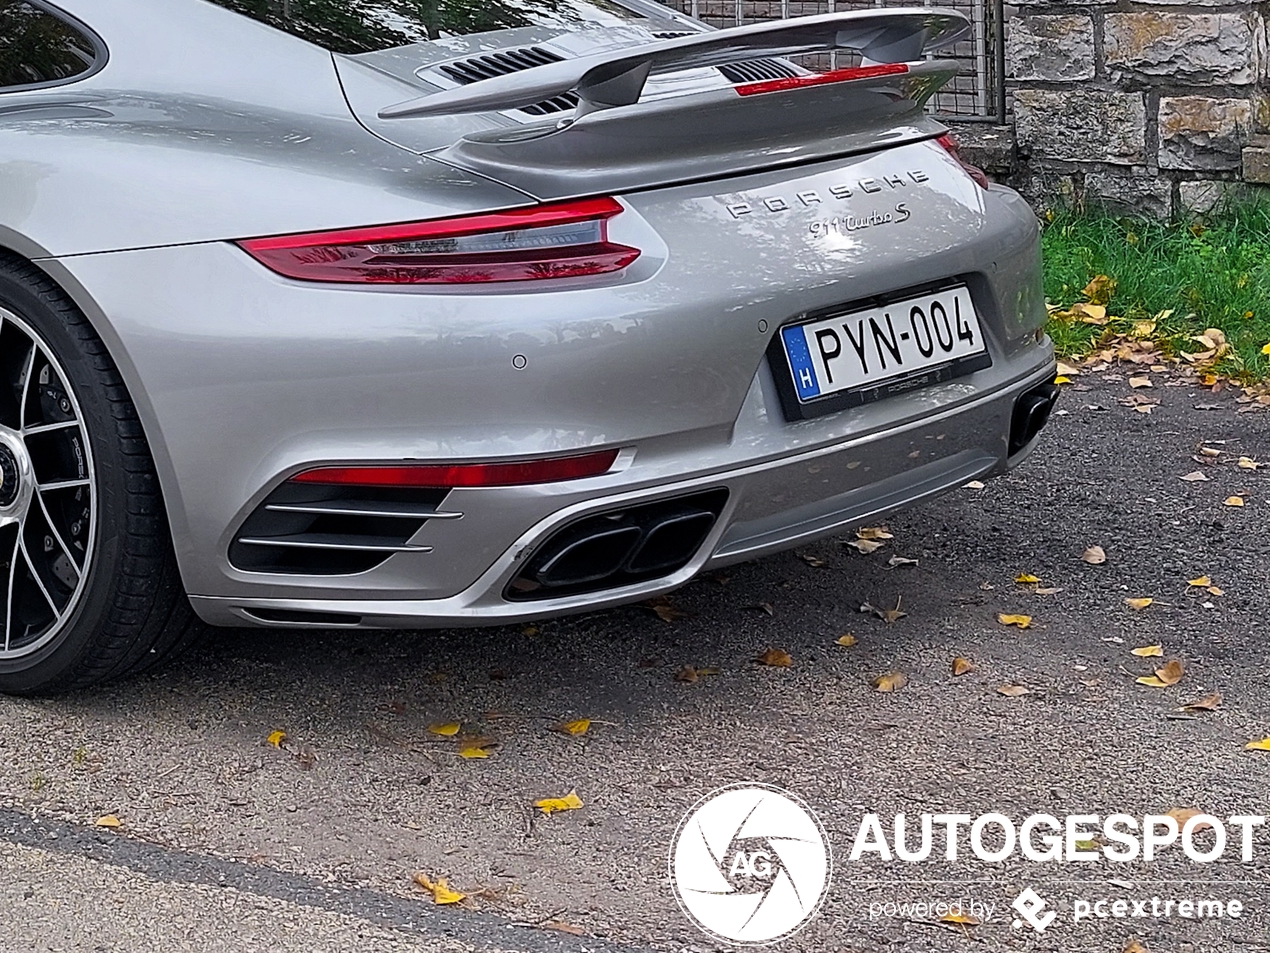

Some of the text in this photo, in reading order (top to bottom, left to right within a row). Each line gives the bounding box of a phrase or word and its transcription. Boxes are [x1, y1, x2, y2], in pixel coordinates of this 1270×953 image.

[726, 169, 929, 219] PORSCHE
[809, 201, 911, 238] 911 Turbo S
[814, 295, 974, 384] PYN-004
[798, 367, 814, 389] H
[888, 375, 929, 392] PORSCHE
